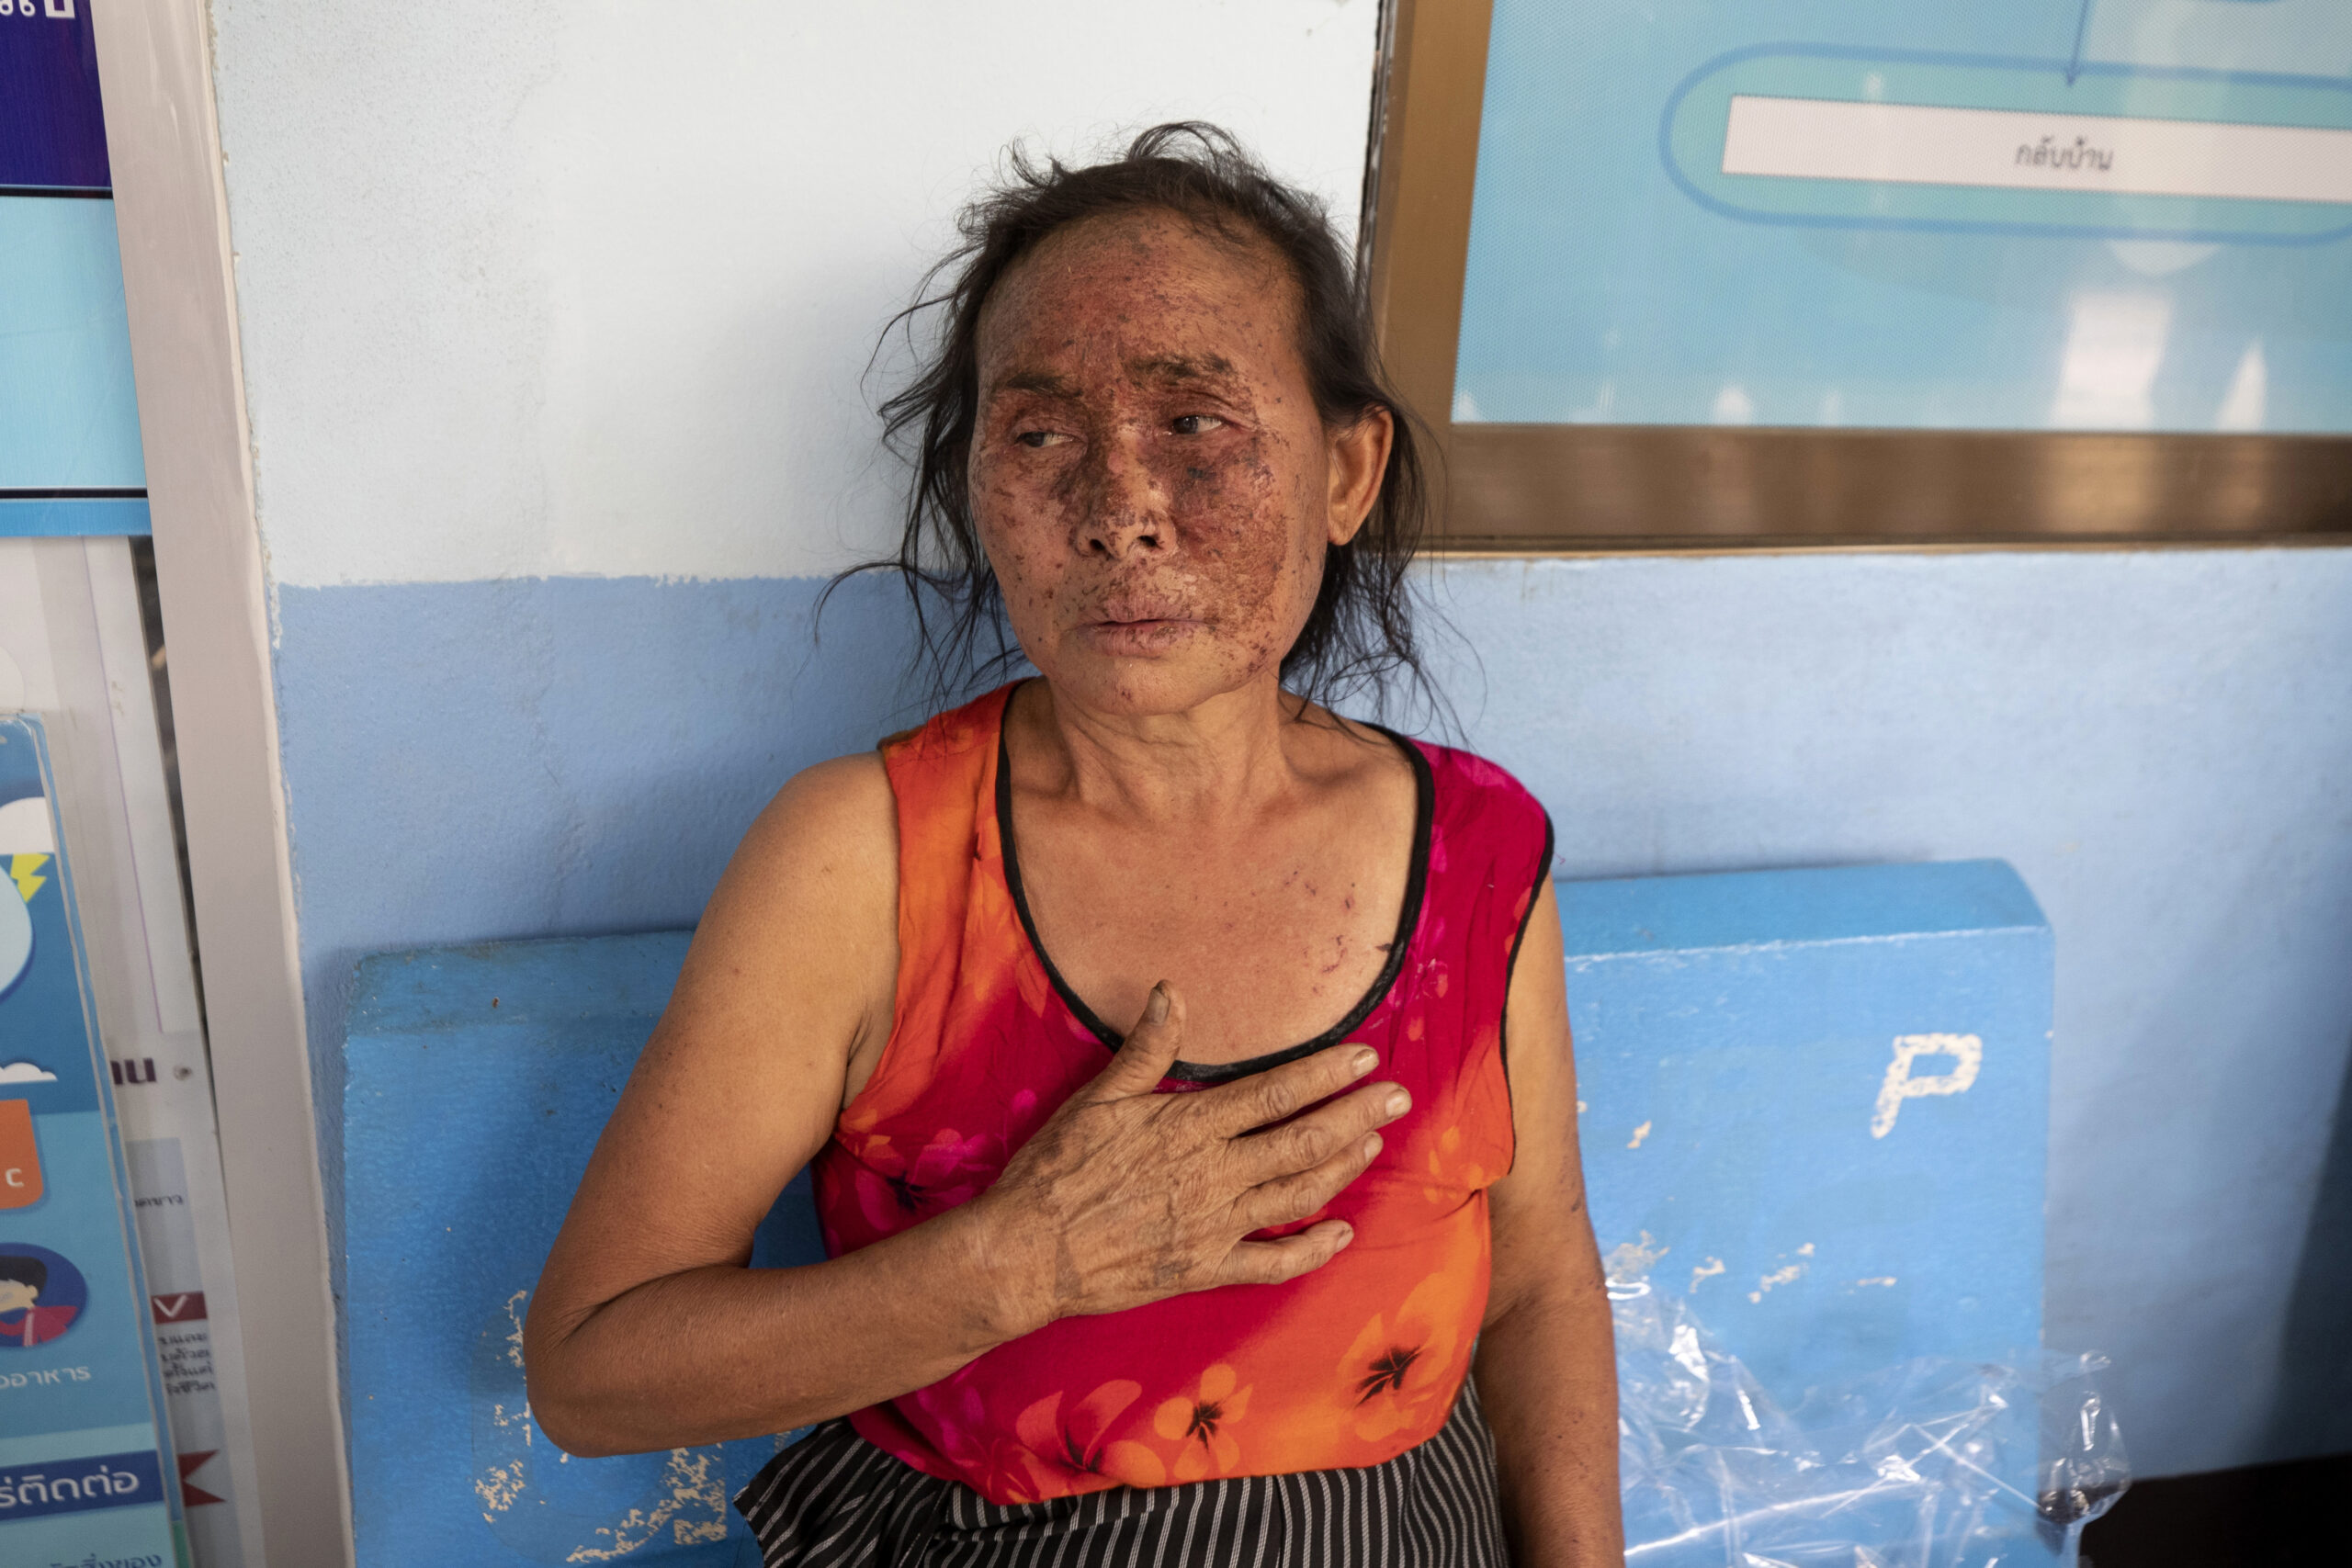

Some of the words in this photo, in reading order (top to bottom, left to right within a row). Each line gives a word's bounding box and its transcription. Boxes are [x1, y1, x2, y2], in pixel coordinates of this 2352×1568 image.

[2016, 135, 2114, 172] กลับบ้าน
[1871, 1032, 1983, 1139] P
